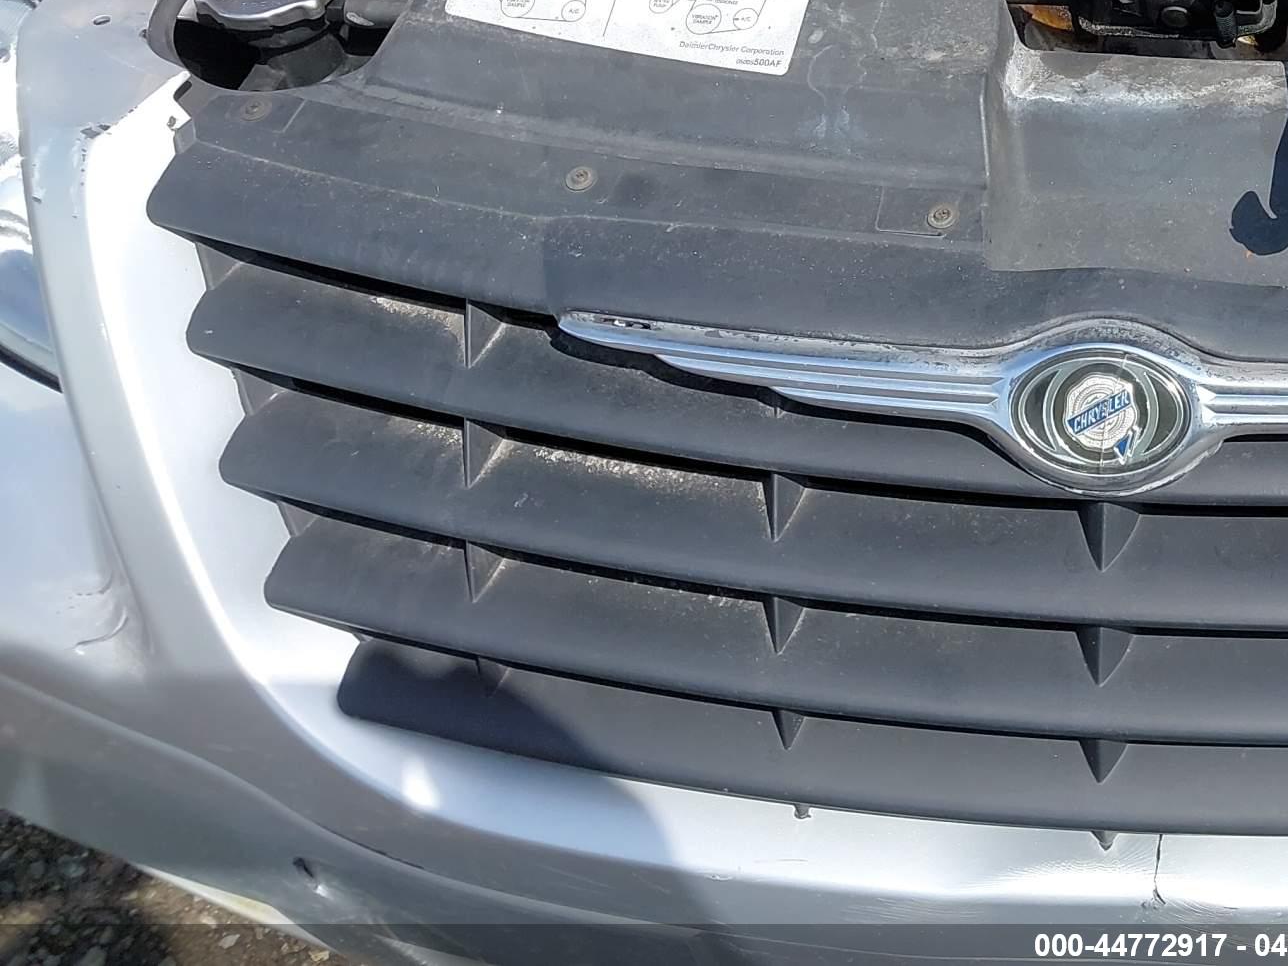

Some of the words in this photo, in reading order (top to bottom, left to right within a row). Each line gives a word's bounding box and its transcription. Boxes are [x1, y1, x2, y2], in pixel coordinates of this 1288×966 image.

[679, 40, 740, 54] DaimlerChrysler
[740, 46, 785, 56] Corporation
[1074, 389, 1131, 433] CHRYSLER
